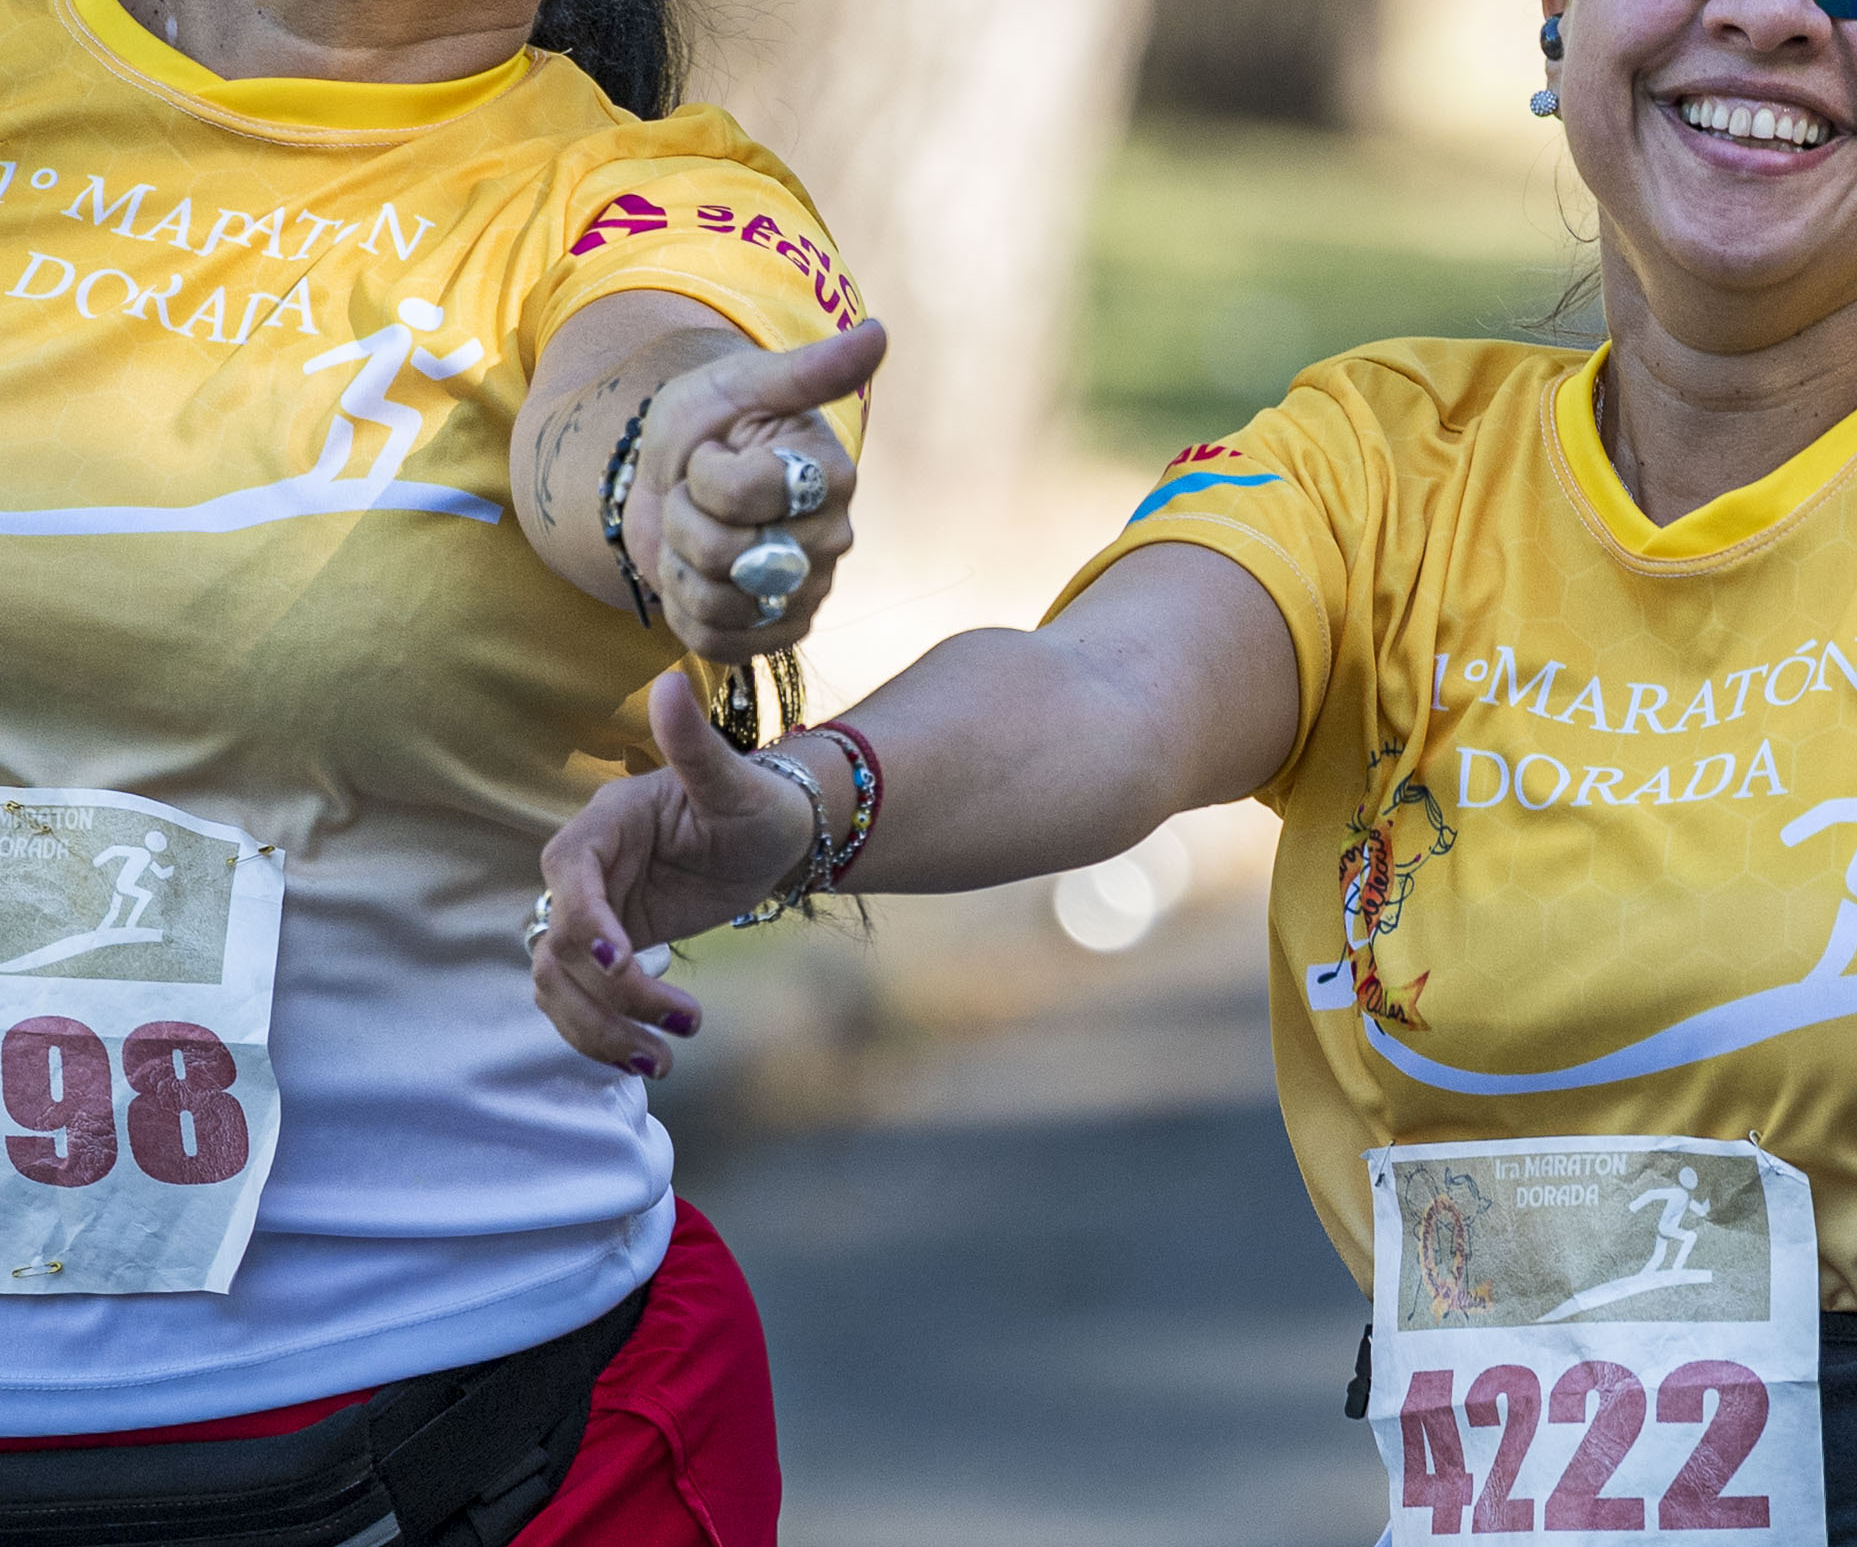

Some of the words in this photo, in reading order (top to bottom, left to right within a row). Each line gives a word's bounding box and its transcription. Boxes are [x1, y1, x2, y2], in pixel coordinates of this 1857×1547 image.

[60, 174, 436, 261] MARATN
[1455, 738, 1788, 811] DORADA
[1516, 1184, 1600, 1208] DORADA
[1523, 1153, 1628, 1178] MARATON
[1399, 1359, 1771, 1536] 4222
